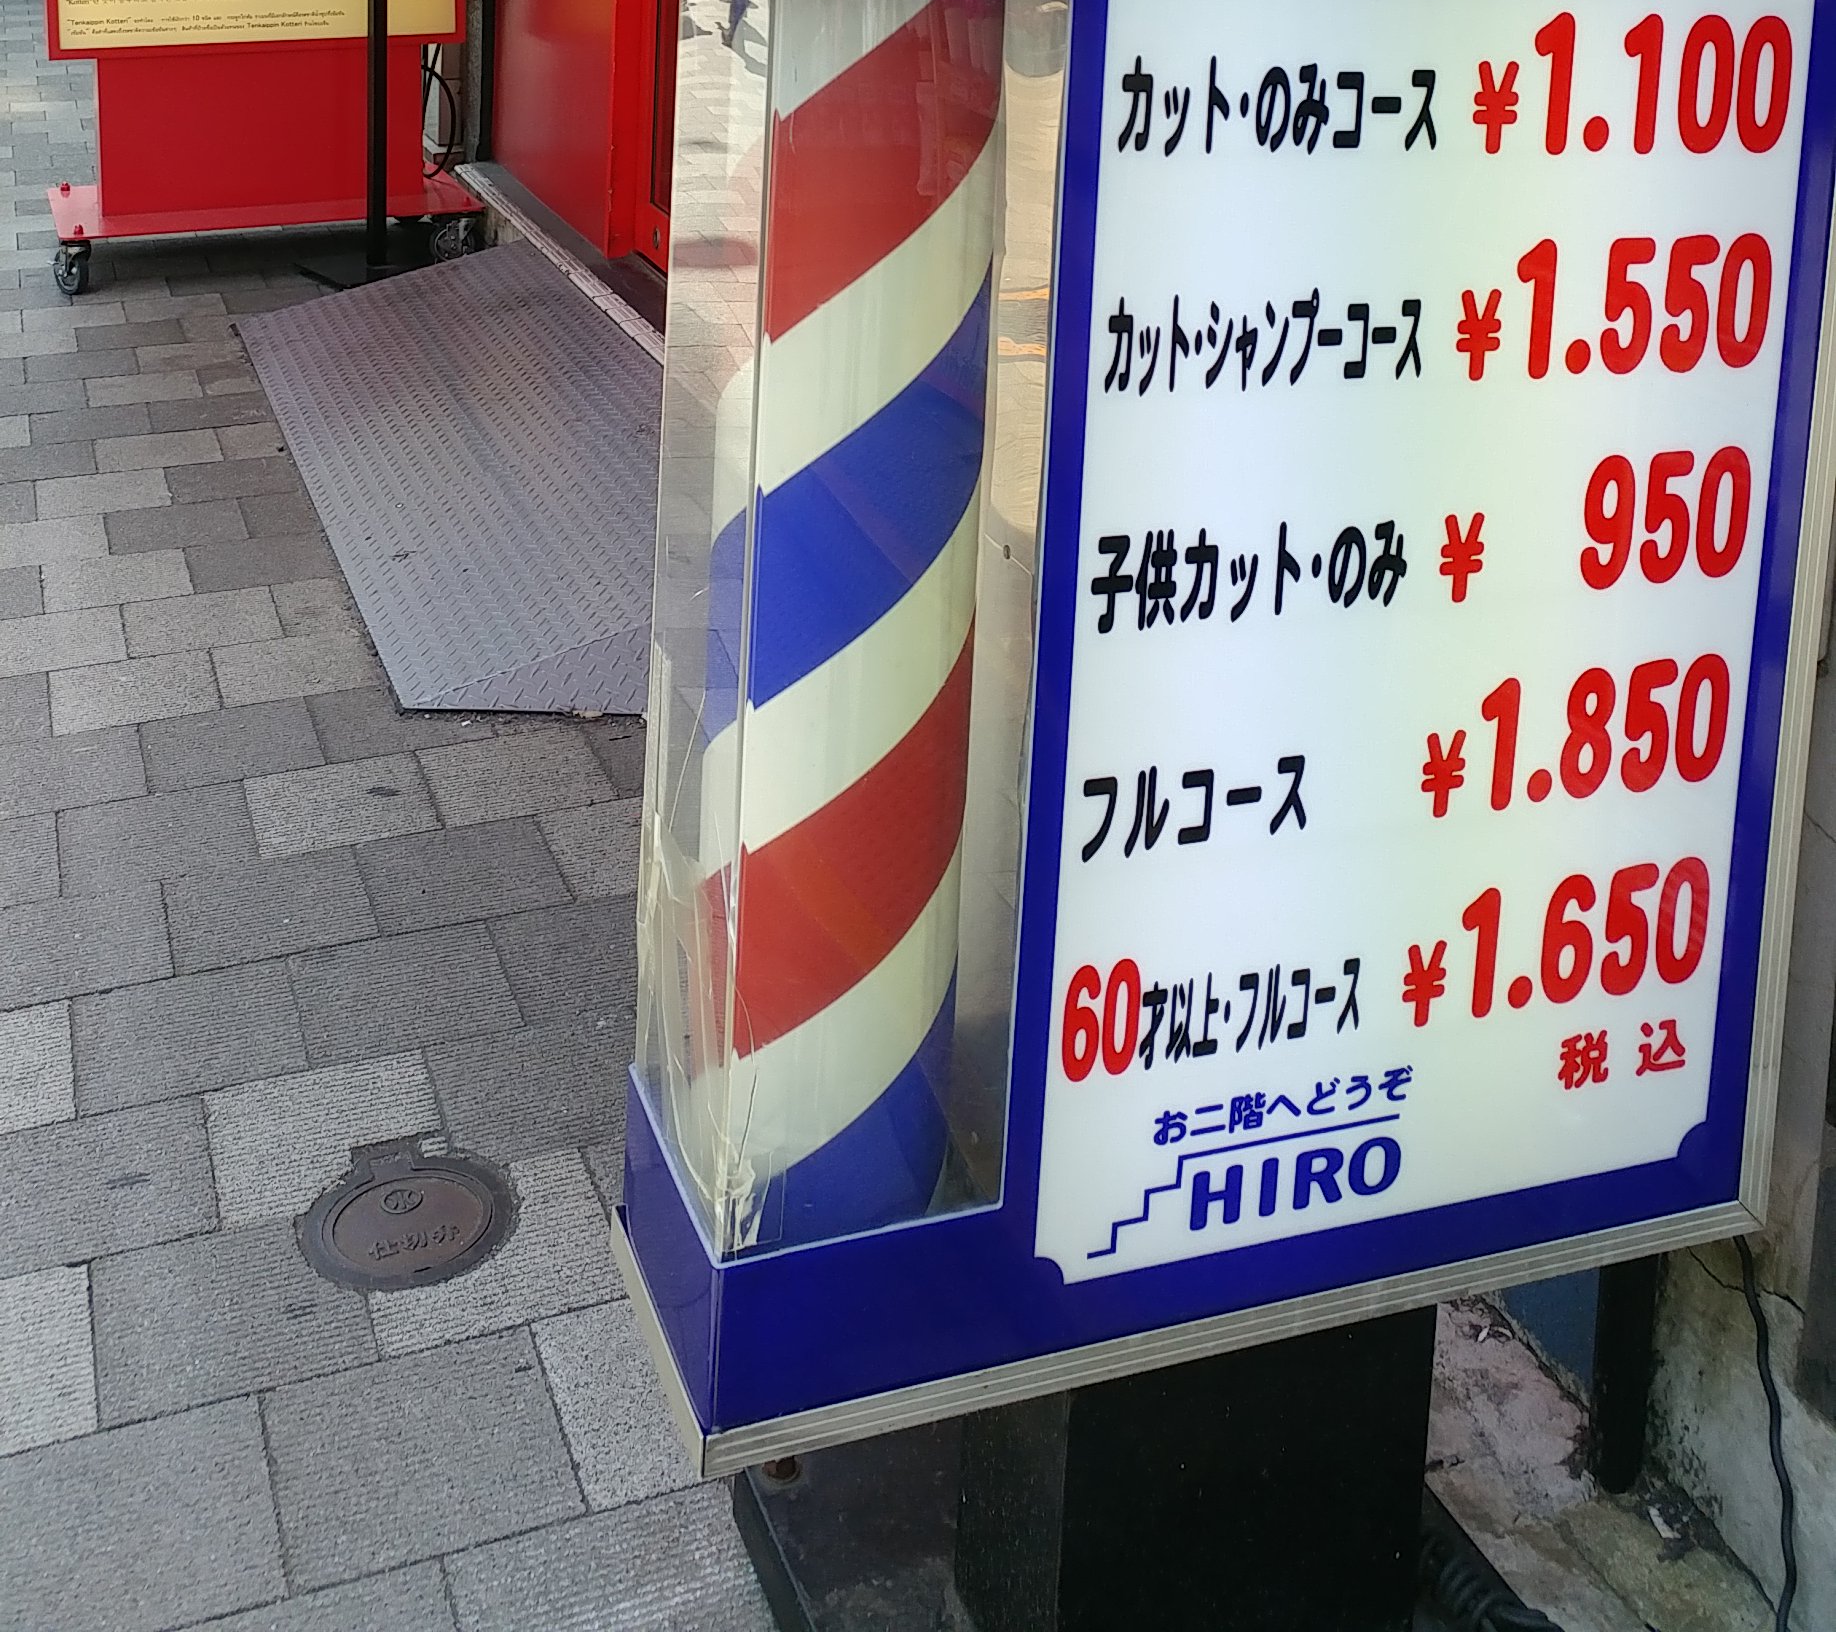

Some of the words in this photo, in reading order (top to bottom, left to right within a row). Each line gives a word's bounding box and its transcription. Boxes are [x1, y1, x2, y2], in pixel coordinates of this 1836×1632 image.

[1118, 56, 1438, 157] カット・のみコース
[1105, 288, 1422, 396] カット・シャンプーコース
[1091, 521, 1408, 635] 子供カット・のみ
[1081, 755, 1307, 864] フルコース
[1153, 1065, 1414, 1147] お二階へどうぞ
[1188, 1135, 1401, 1231] HIRO
